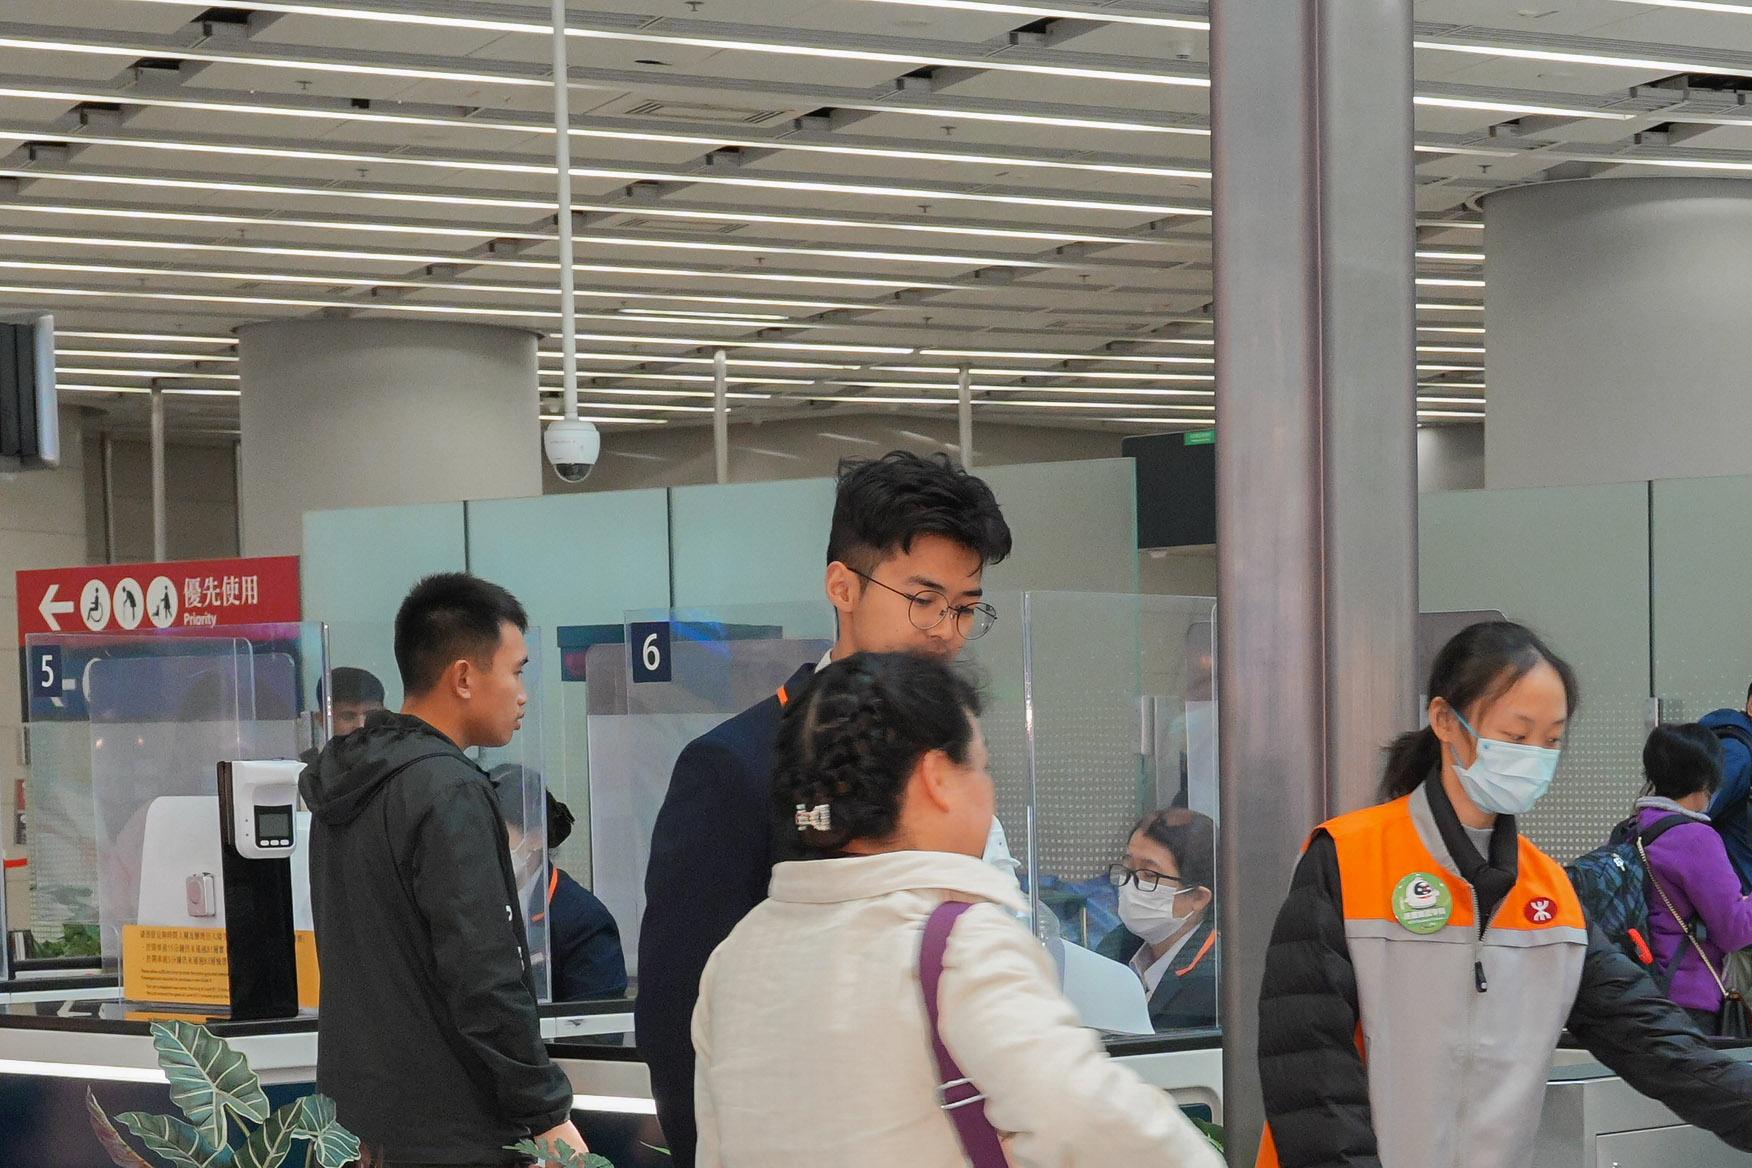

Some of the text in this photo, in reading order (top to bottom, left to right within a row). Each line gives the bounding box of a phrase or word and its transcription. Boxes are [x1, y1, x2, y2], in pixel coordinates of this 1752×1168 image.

[183, 575, 258, 608] 優先使用
[183, 611, 217, 629] Priority
[642, 633, 661, 671] 6
[41, 654, 55, 688] 5
